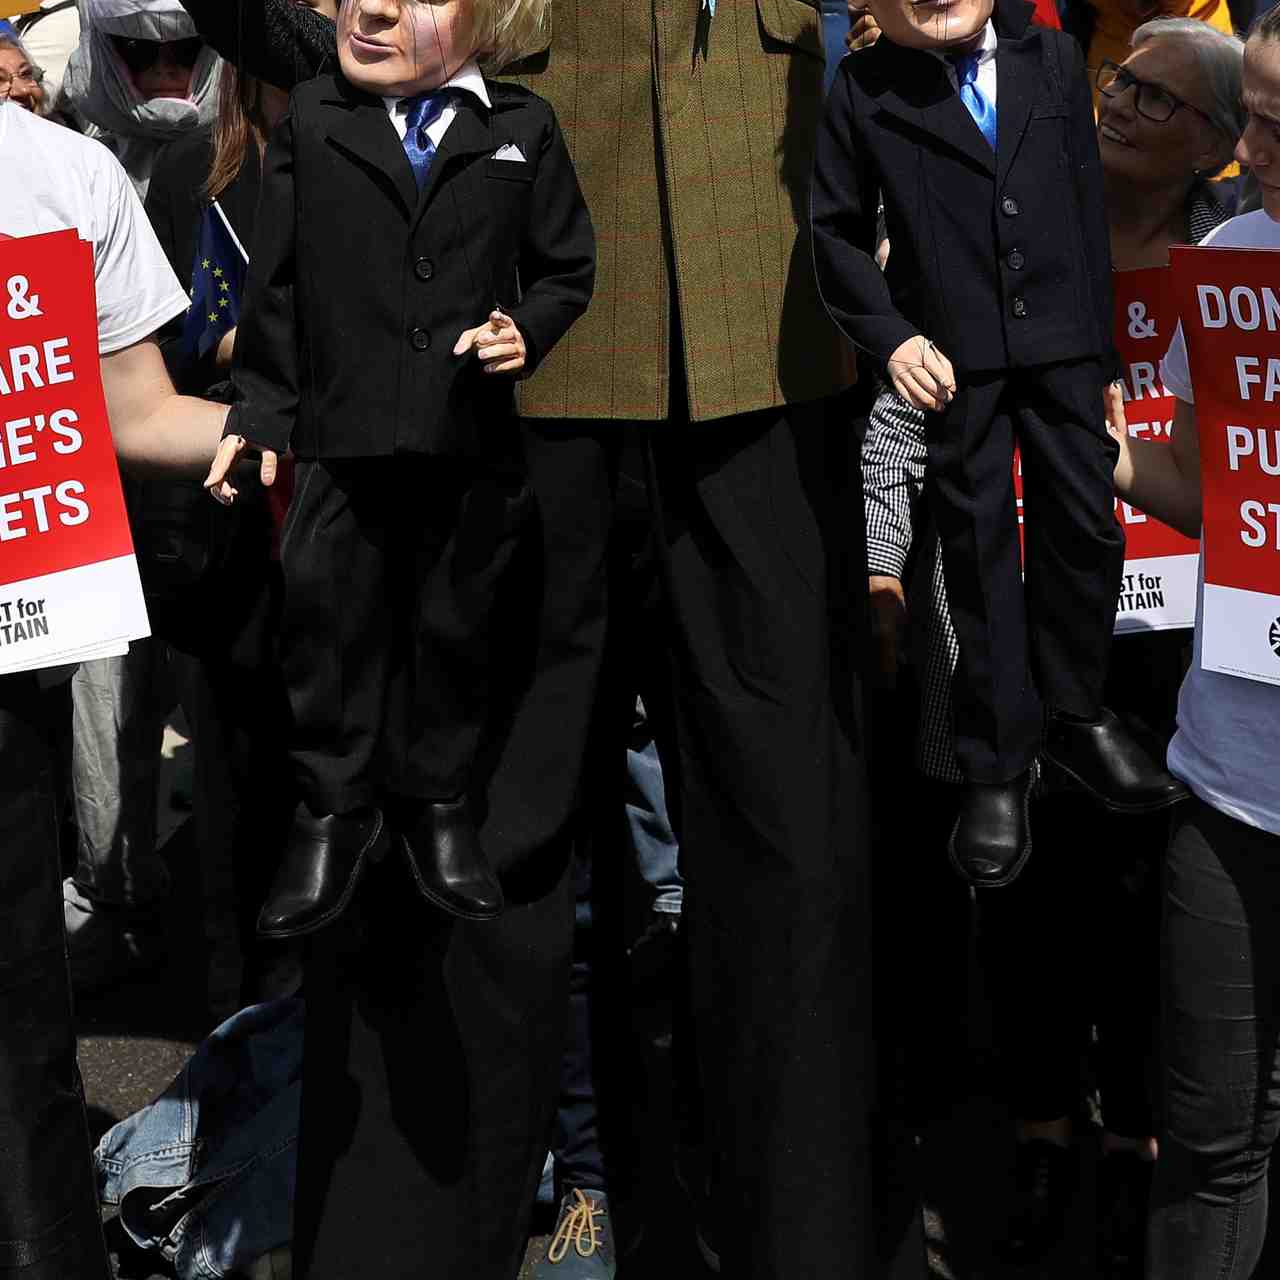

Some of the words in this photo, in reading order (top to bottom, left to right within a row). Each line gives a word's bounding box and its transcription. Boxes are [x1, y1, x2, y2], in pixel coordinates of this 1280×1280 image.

[6, 274, 44, 320] &
[1127, 301, 1159, 339] &
[1138, 573, 1162, 592] for
[16, 597, 46, 619] for
